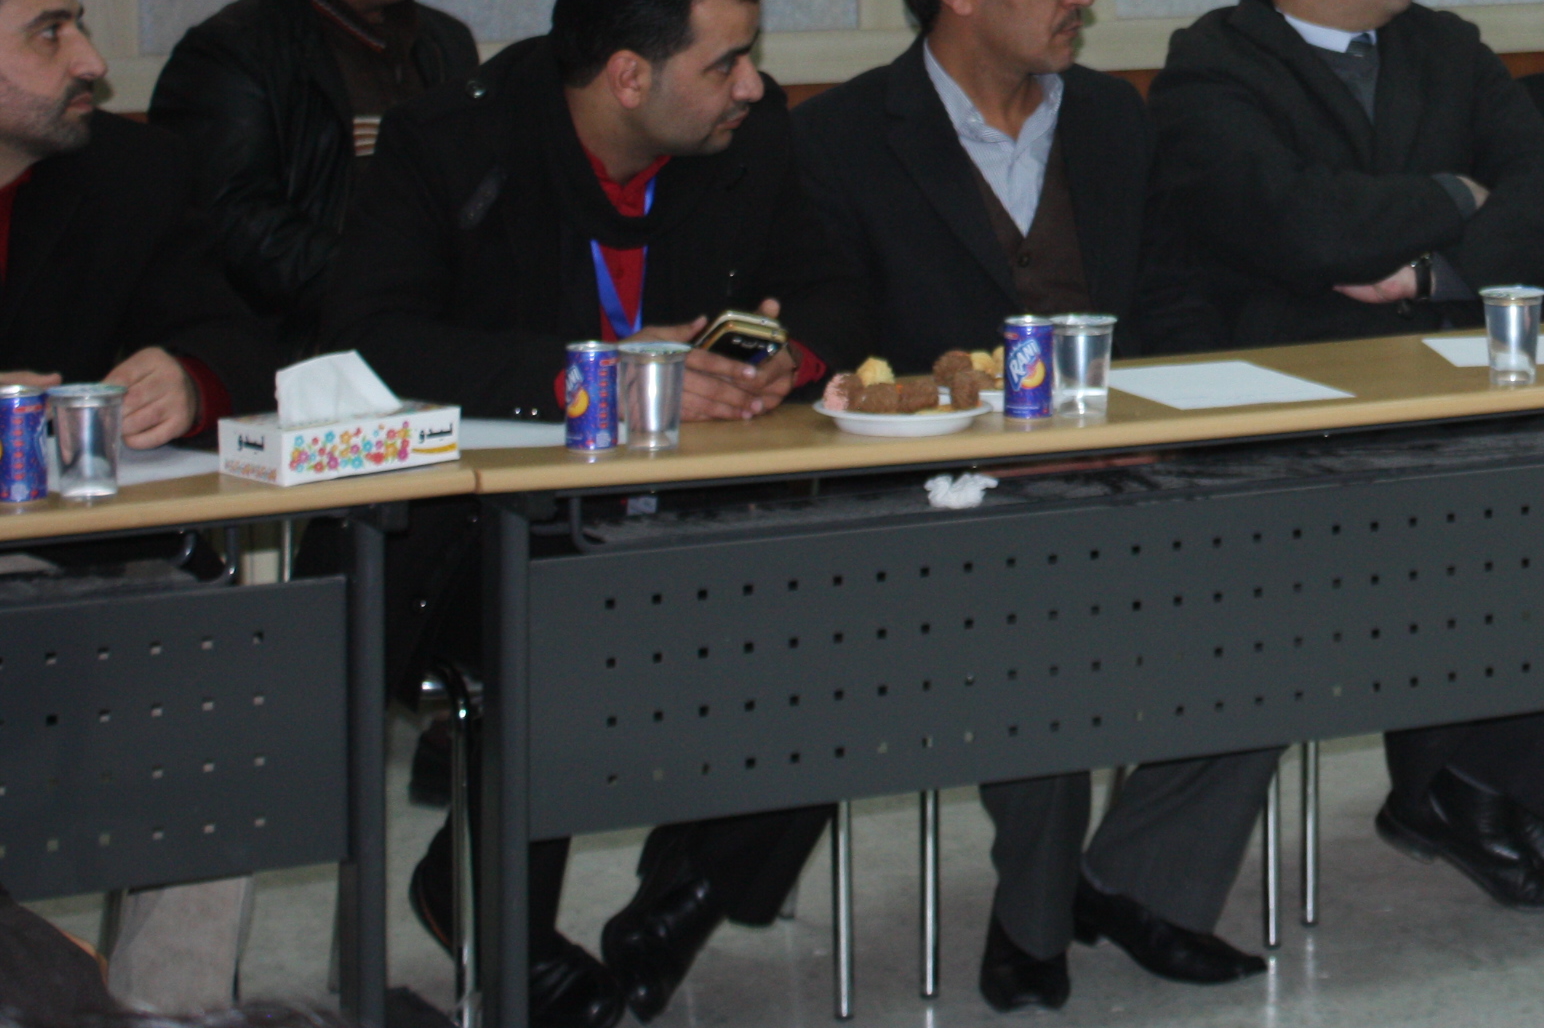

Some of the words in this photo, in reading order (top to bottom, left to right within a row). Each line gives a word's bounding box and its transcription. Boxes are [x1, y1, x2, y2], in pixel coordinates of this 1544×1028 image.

[1008, 339, 1041, 384] RANI
[418, 422, 453, 444] ليدو
[237, 434, 265, 455] ليدو
